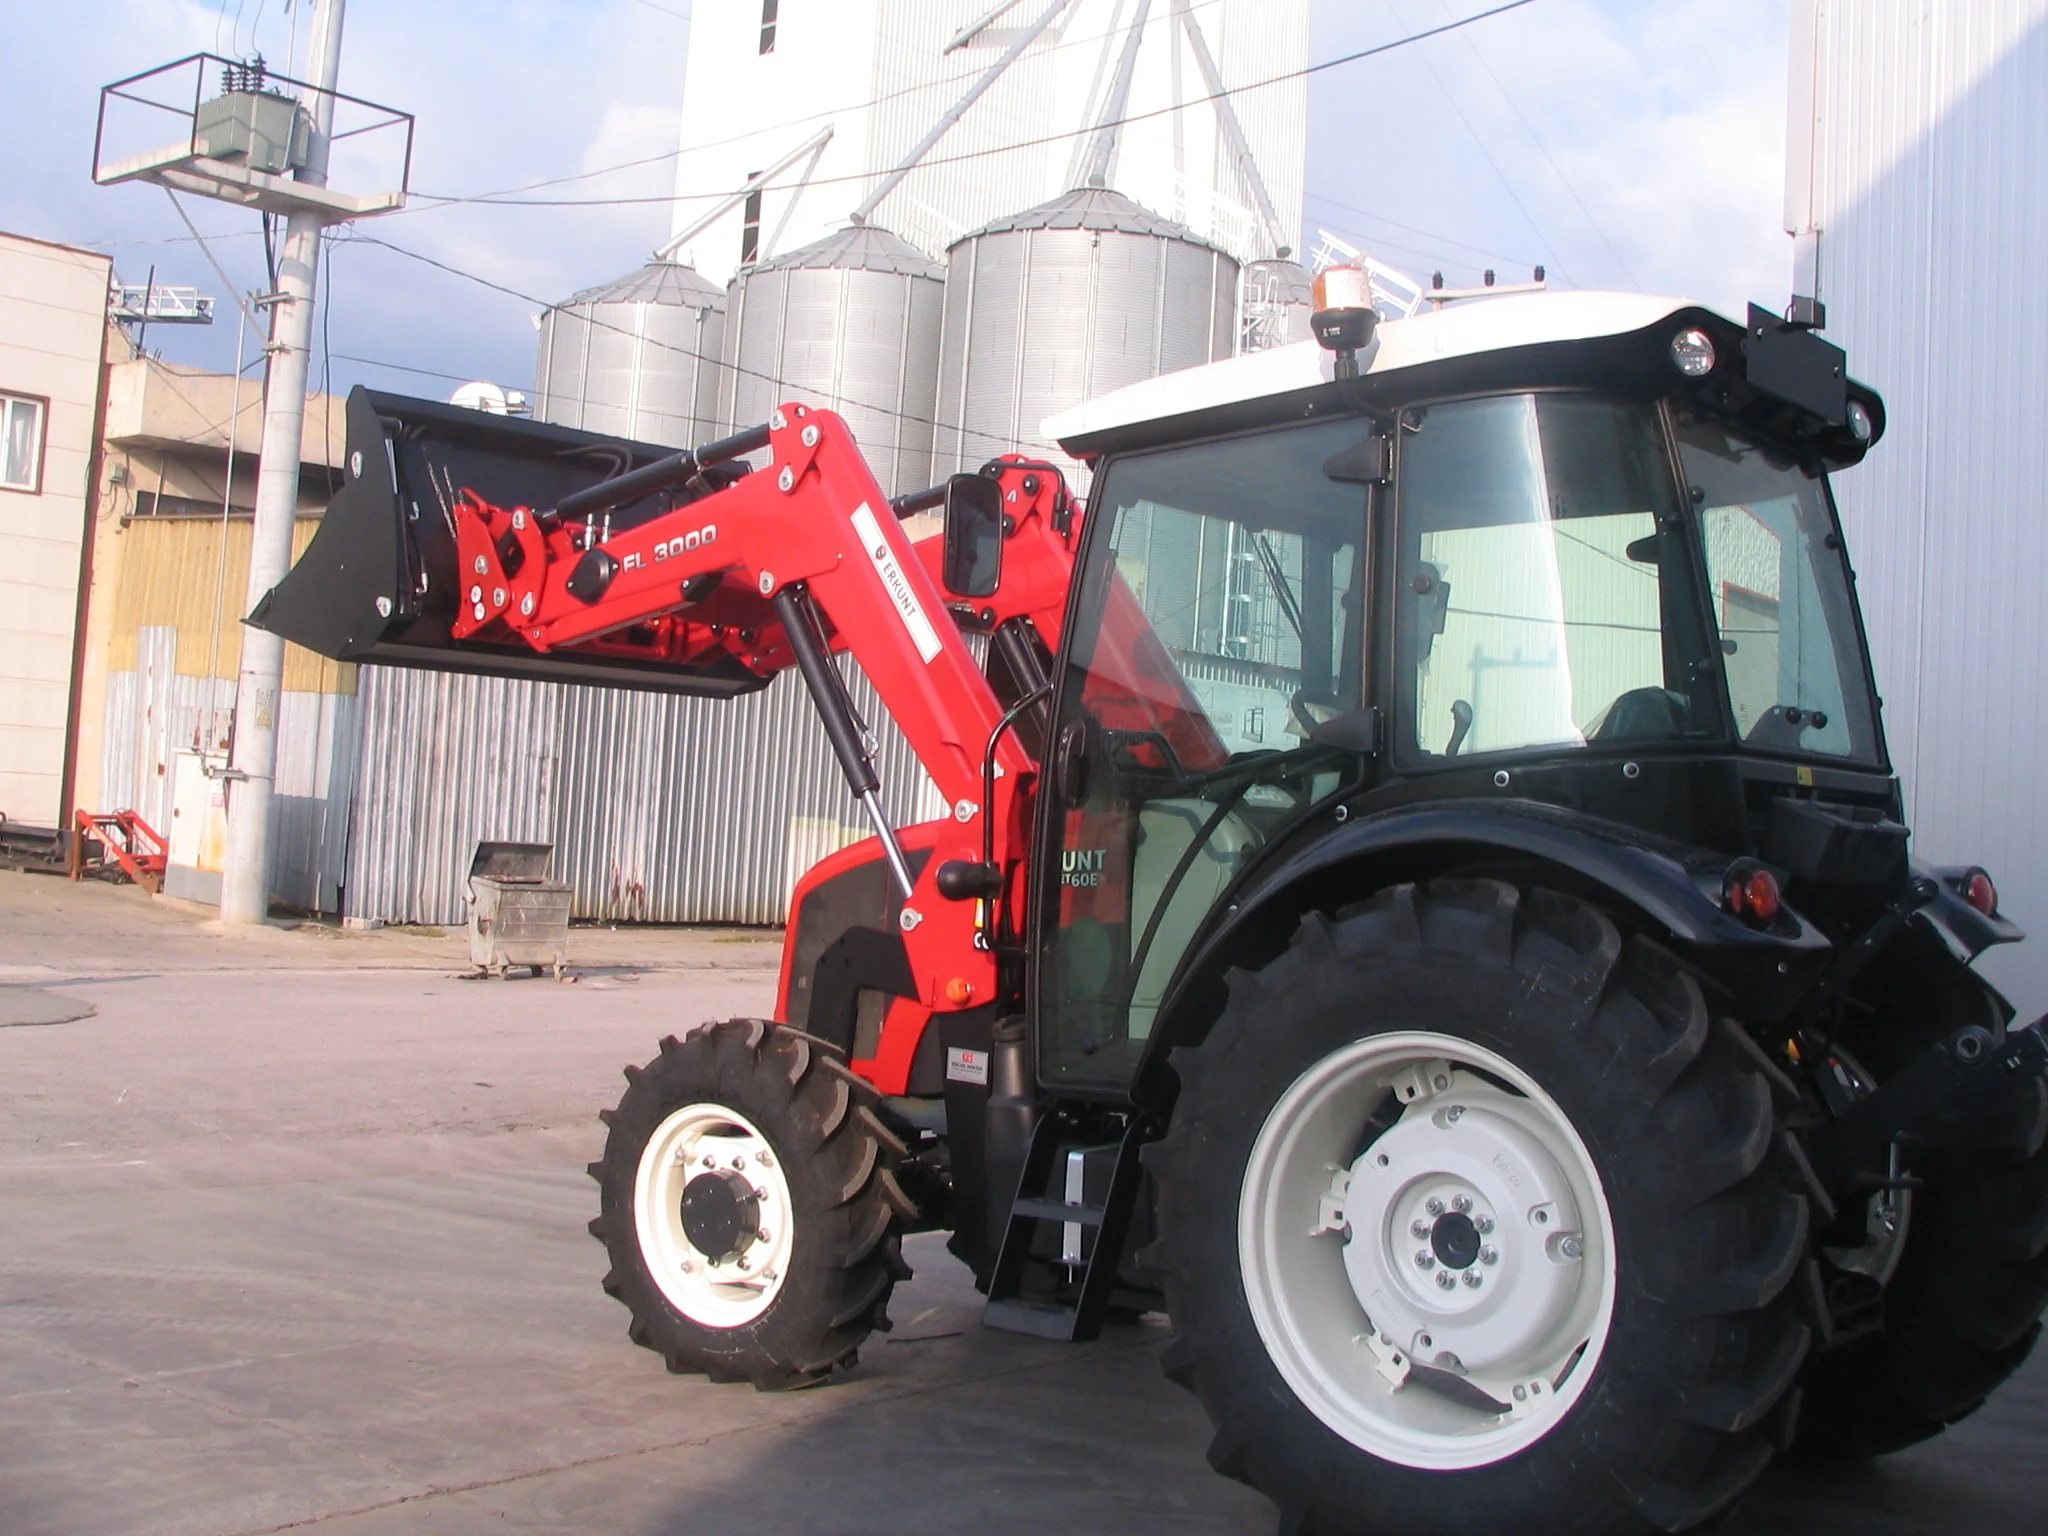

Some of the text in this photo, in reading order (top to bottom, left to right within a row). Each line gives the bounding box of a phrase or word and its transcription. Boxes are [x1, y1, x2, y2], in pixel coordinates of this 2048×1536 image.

[623, 524, 717, 573] FL 3000
[883, 562, 917, 617] ERKUNT
